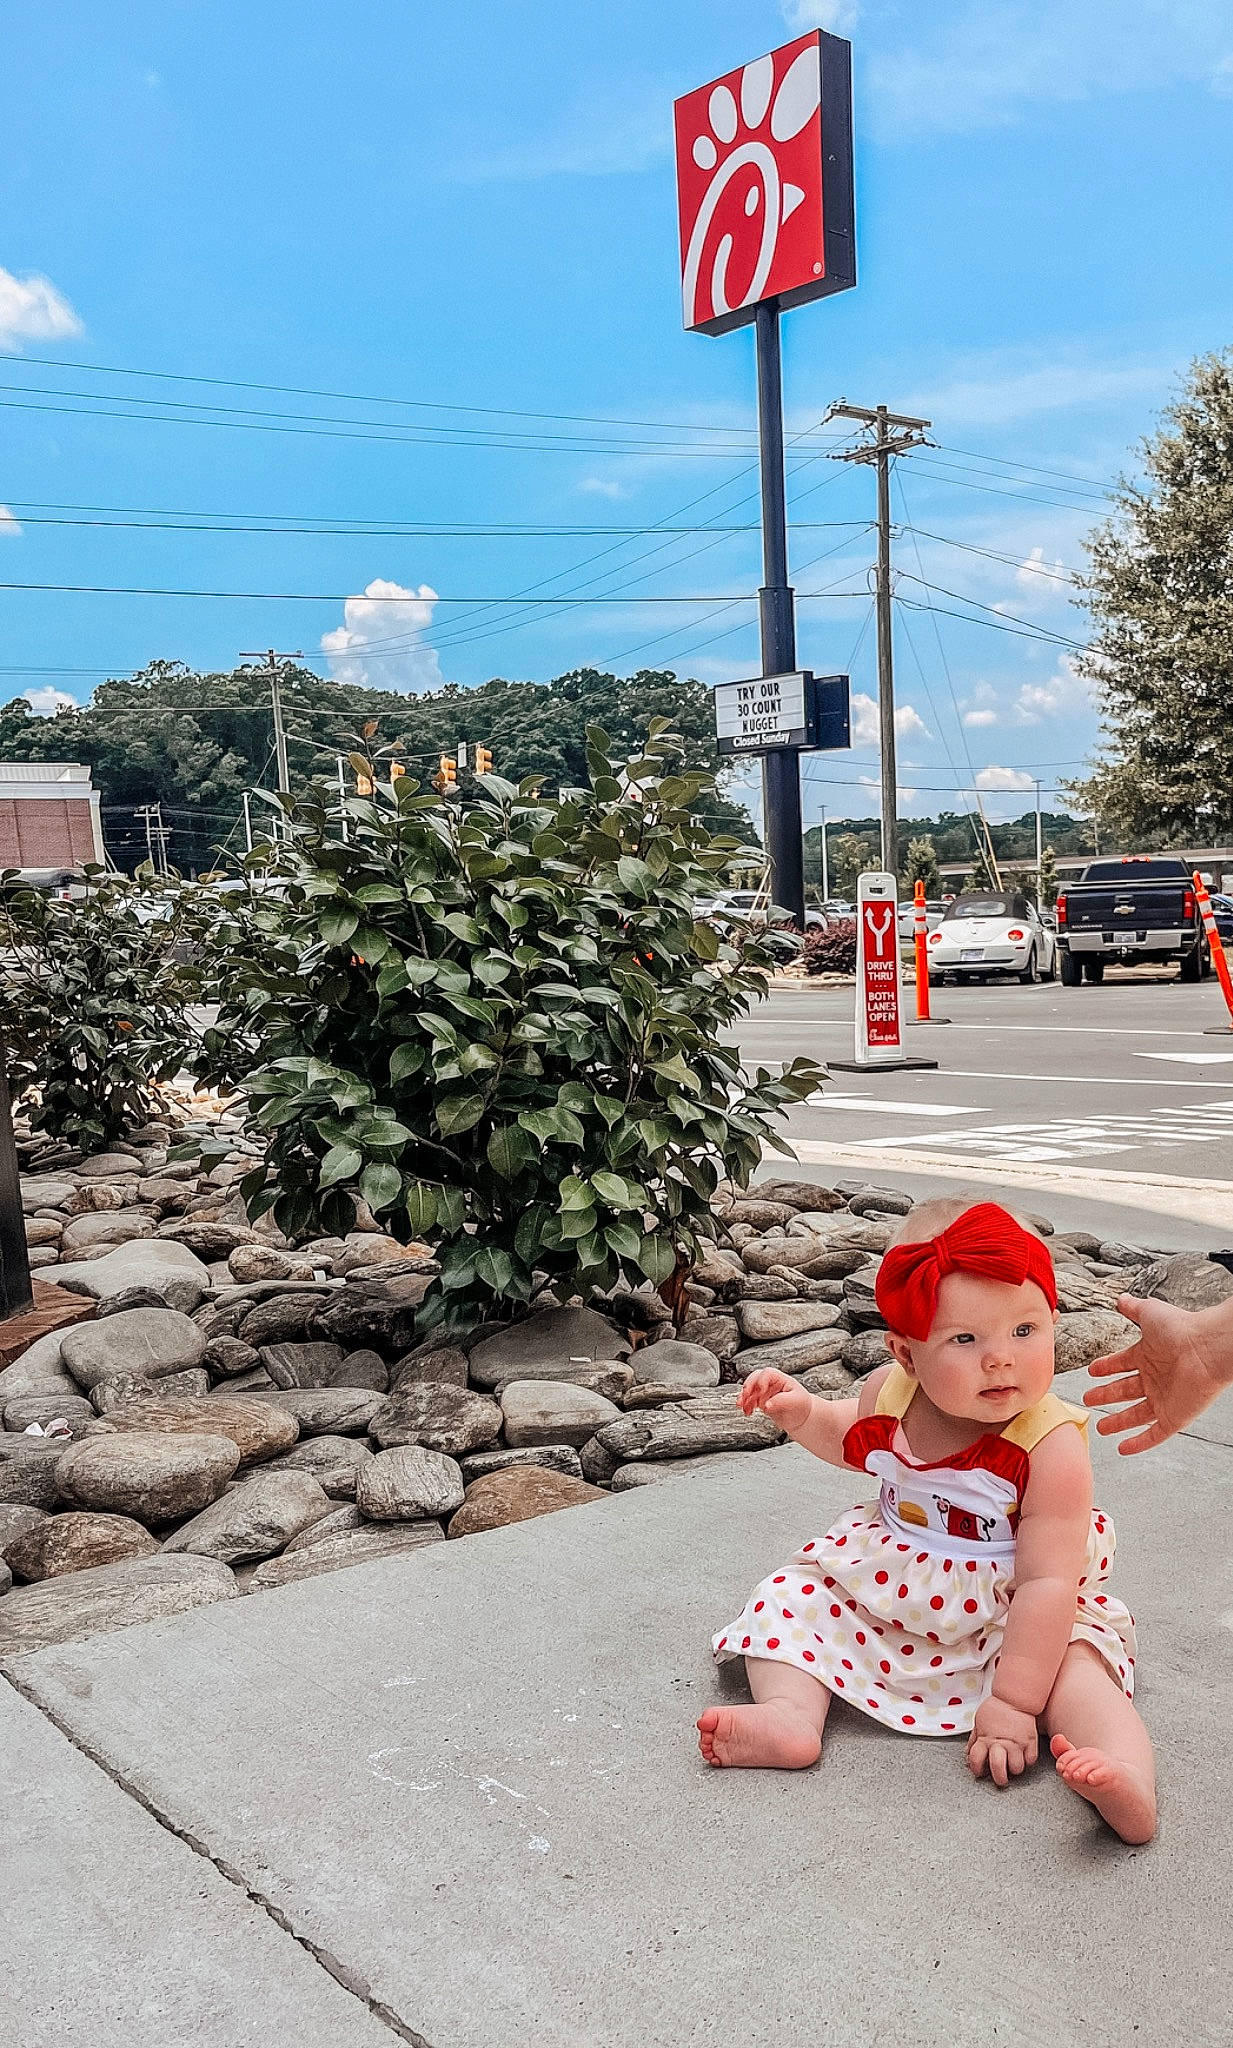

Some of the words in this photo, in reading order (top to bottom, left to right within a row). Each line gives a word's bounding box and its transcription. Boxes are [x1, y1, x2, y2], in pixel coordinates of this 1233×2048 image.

[737, 685, 756, 701] TRY
[760, 682, 780, 698] OUR
[738, 703, 750, 717] 30
[752, 699, 782, 716] COUNT
[742, 716, 778, 733] NUGGET
[733, 733, 761, 748] Closed
[761, 731, 790, 745] Sunday
[867, 961, 895, 971] DRIVE
[867, 971, 894, 981] THRU
[868, 991, 895, 1001] BOTH
[867, 1001, 897, 1012] LANES
[869, 1012, 896, 1022] OPEN
